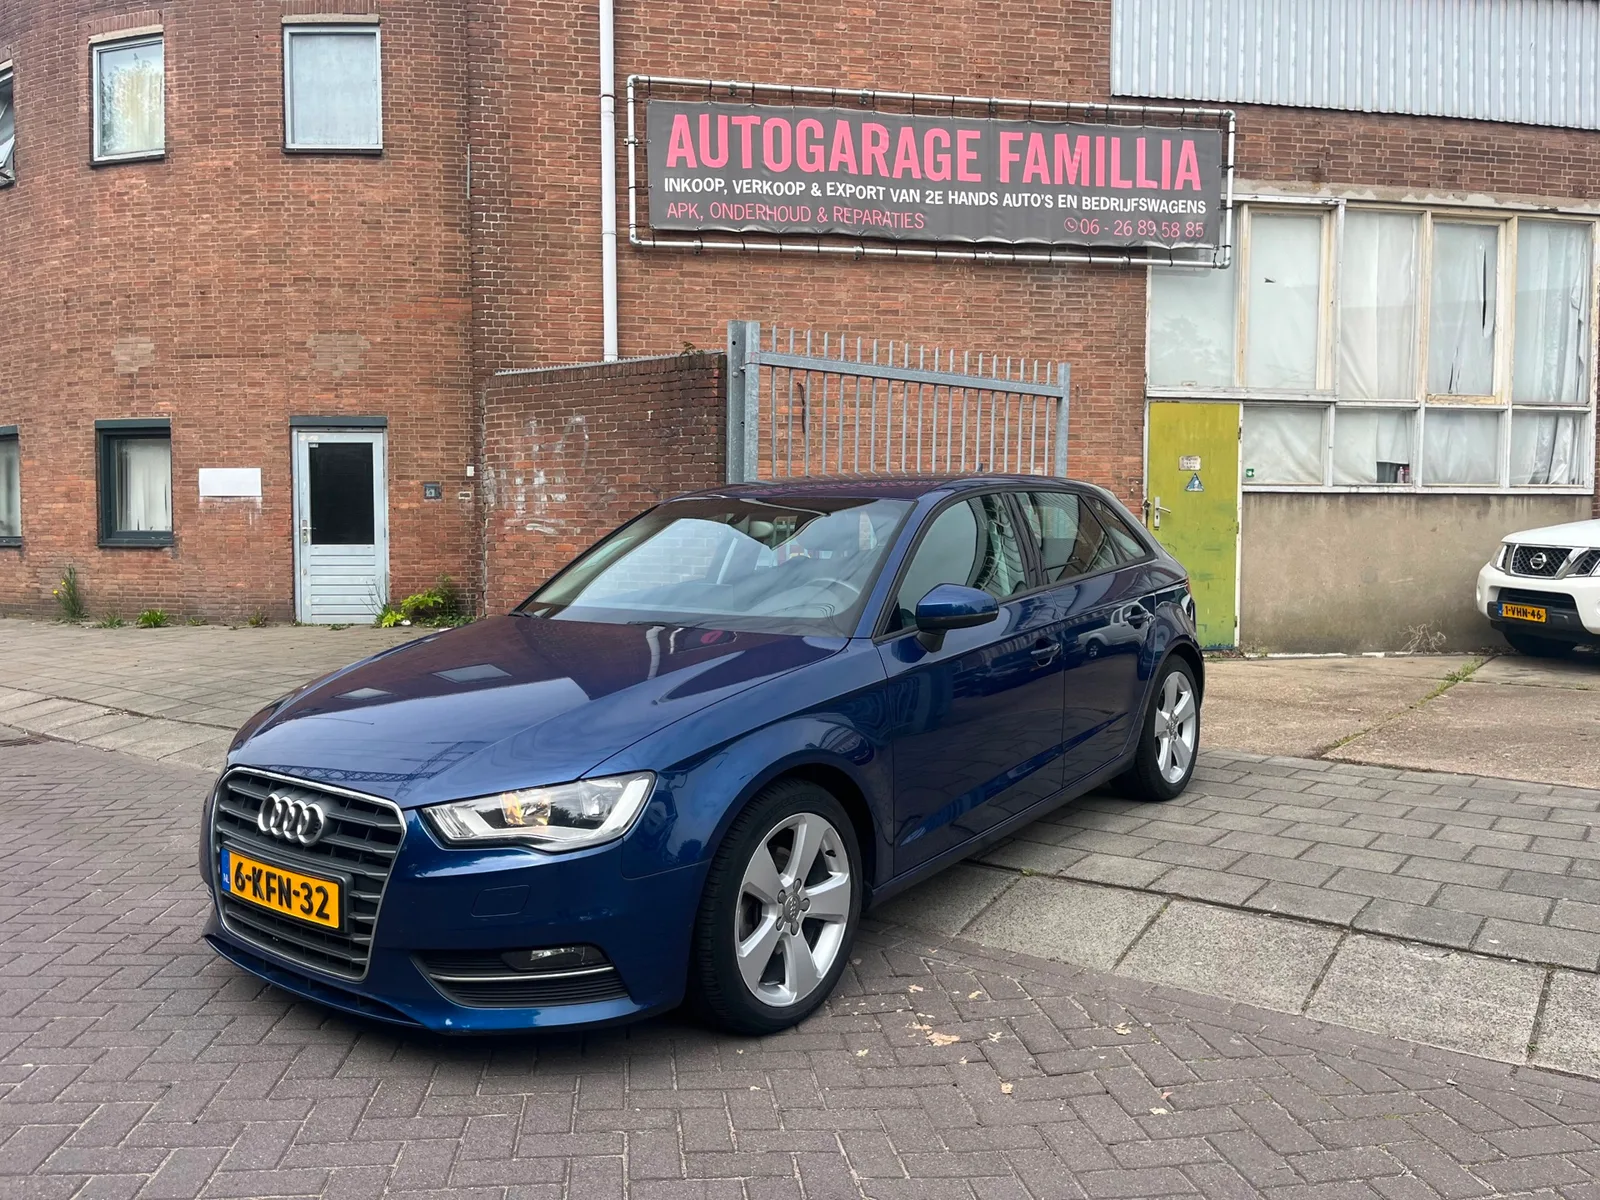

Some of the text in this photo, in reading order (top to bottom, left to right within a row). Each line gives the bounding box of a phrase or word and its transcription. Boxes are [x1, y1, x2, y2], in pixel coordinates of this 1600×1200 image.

[666, 113, 1202, 191] AUTOGARAGE FAMILLIA
[664, 177, 1207, 214] INKOOP, VERKOOP & EXPORT VAN 2E HANDS AUTO'S EN BEDRIJFSWAGENS
[667, 202, 925, 229] APK, ONDERHOUD & REPARATIES
[1079, 218, 1100, 235] 06
[1113, 219, 1133, 237] 26
[1137, 219, 1157, 237] 89
[1161, 221, 1180, 238] 58
[1184, 221, 1204, 238] 85
[1505, 605, 1543, 620] 1-VHN-46
[234, 861, 330, 920] 6-KFN-32
